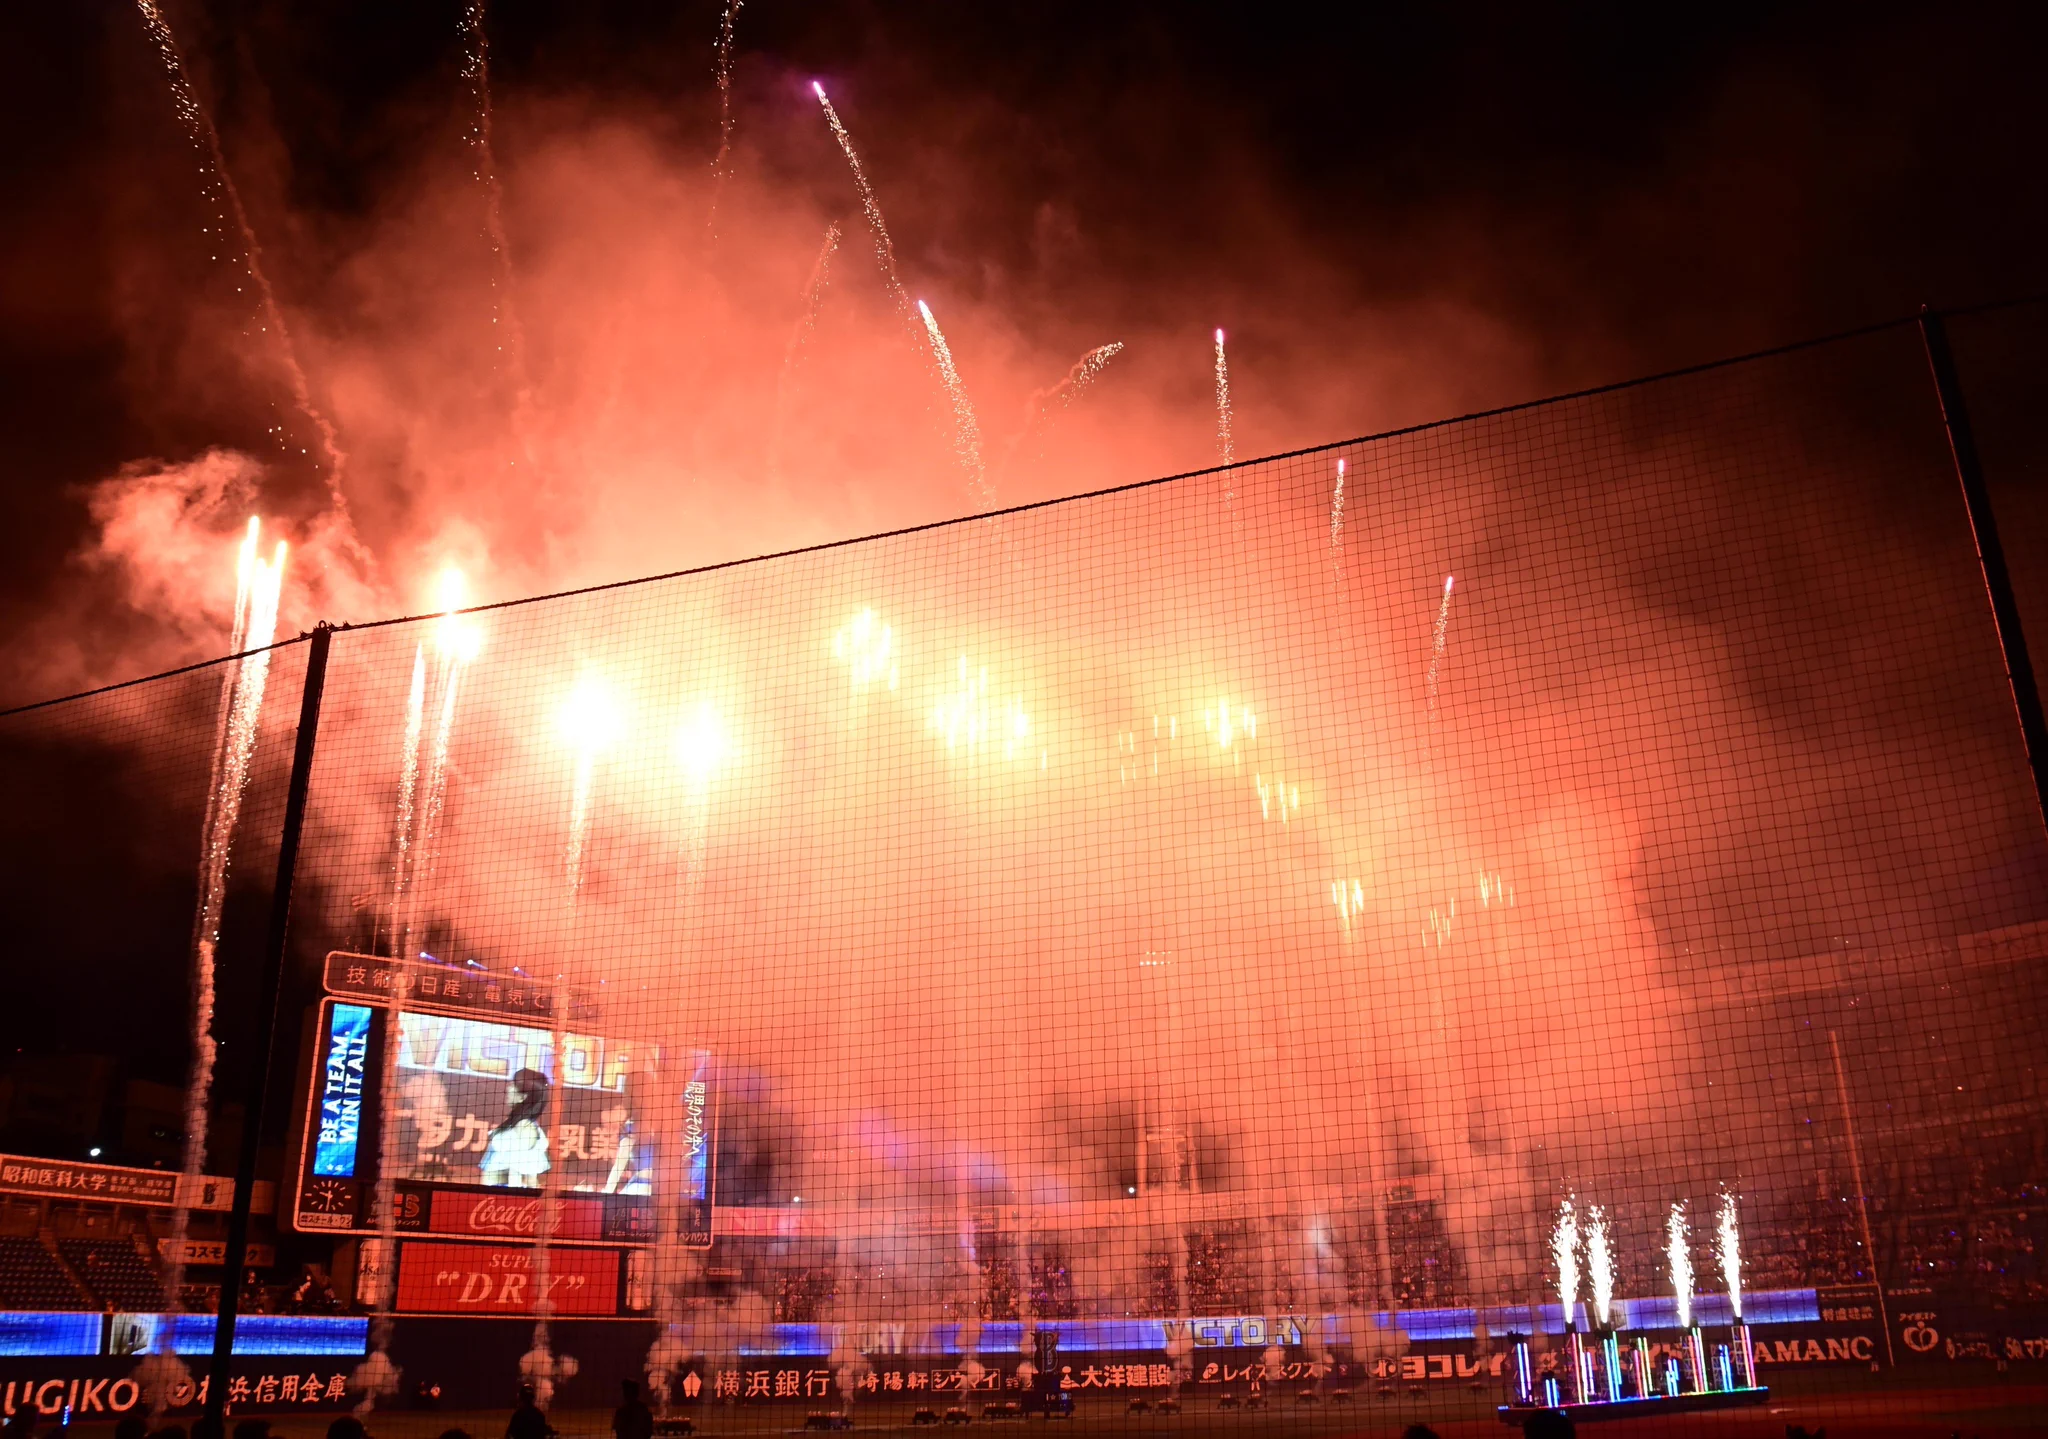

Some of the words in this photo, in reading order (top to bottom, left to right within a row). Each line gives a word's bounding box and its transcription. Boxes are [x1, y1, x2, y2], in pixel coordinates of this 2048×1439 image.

[326, 1030, 351, 1094] TEAM.
[347, 1033, 368, 1073] ALL
[344, 1073, 363, 1095] IT
[324, 1098, 342, 1114] A
[319, 1117, 339, 1143] BE
[338, 1099, 361, 1144] WIN
[418, 1112, 622, 1161] タカ乳業
[2, 1164, 107, 1192] 昭和医科大学
[469, 1196, 569, 1234] Coca-Cola
[489, 1253, 548, 1269] SUPE
[1162, 1316, 1317, 1347] VCTORY
[714, 1369, 830, 1398] 横浜銀行
[858, 1370, 929, 1392] 崎陽軒
[1080, 1364, 1171, 1389] 大洋建設
[0, 1378, 139, 1415] UGIKO
